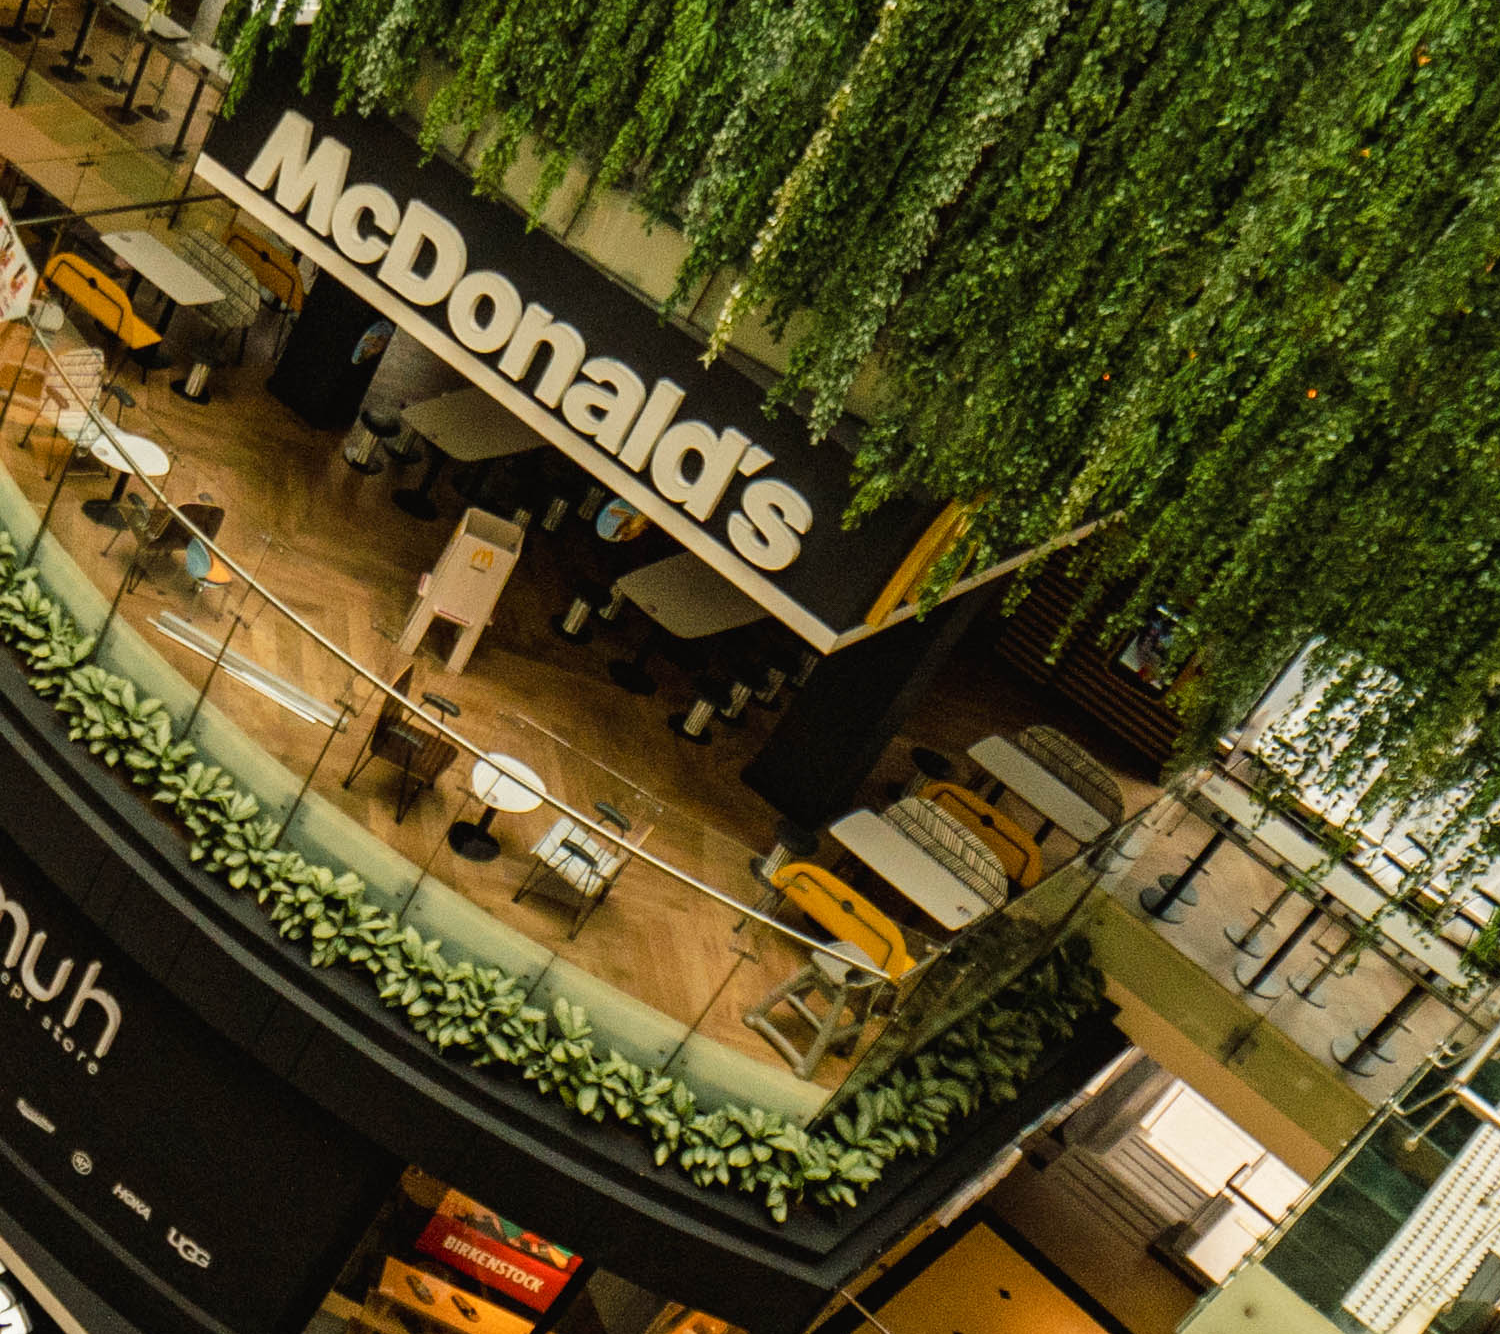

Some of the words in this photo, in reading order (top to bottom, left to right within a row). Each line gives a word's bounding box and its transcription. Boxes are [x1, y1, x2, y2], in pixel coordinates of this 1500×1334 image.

[244, 108, 813, 571] McDonald's
[41, 1014, 100, 1076] store
[112, 1182, 154, 1222] HOKA
[166, 1226, 212, 1270] UGG
[442, 1234, 545, 1294] BIRKENSTOCK
